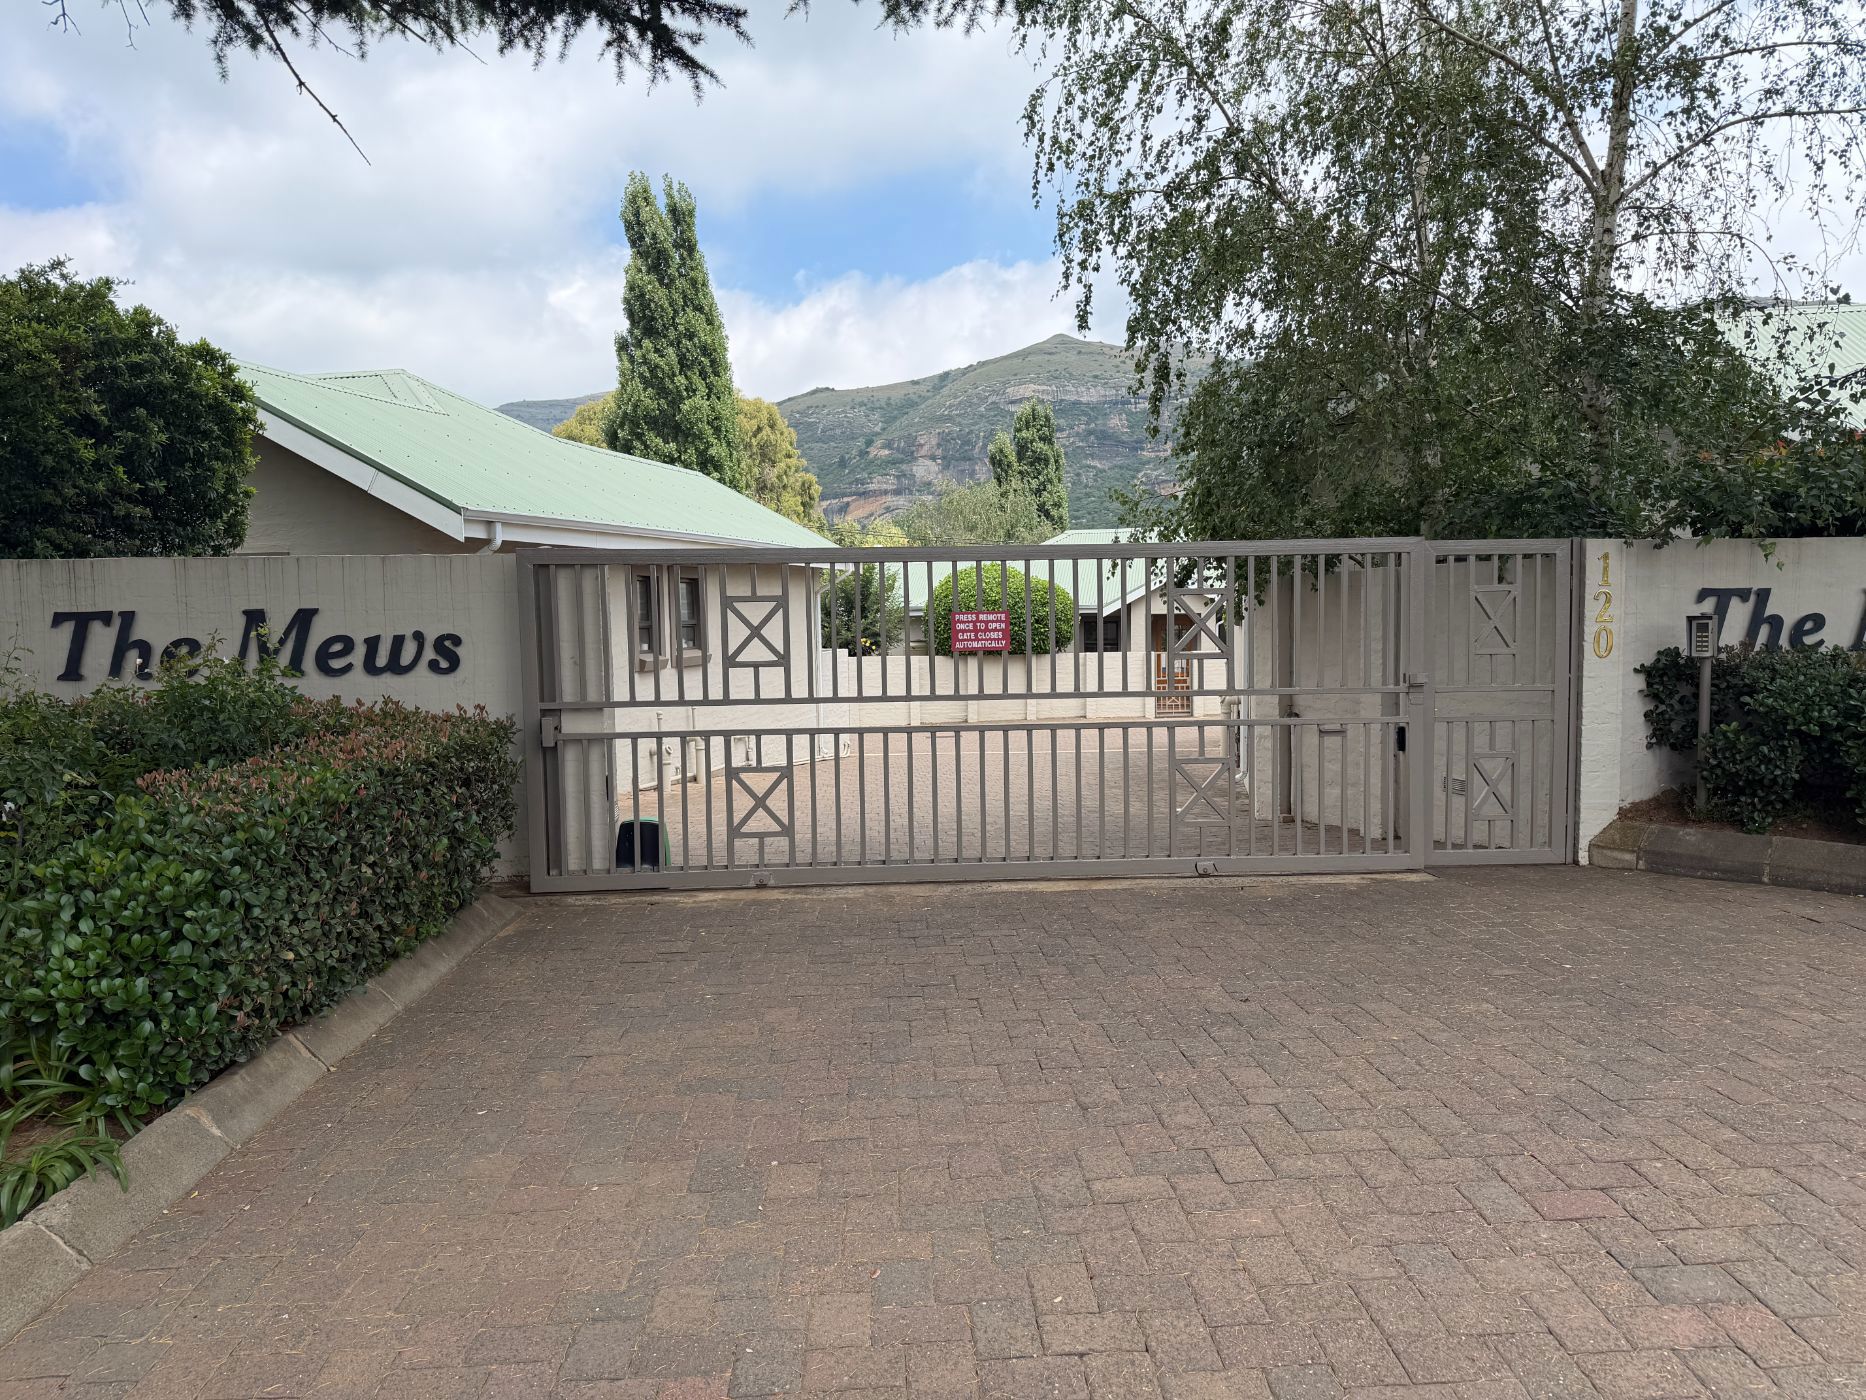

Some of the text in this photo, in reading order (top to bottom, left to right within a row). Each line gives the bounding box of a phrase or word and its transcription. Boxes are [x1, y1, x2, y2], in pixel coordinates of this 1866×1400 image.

[1593, 551, 1615, 659] 120
[1695, 587, 1827, 652] The
[51, 607, 464, 682] The Mews
